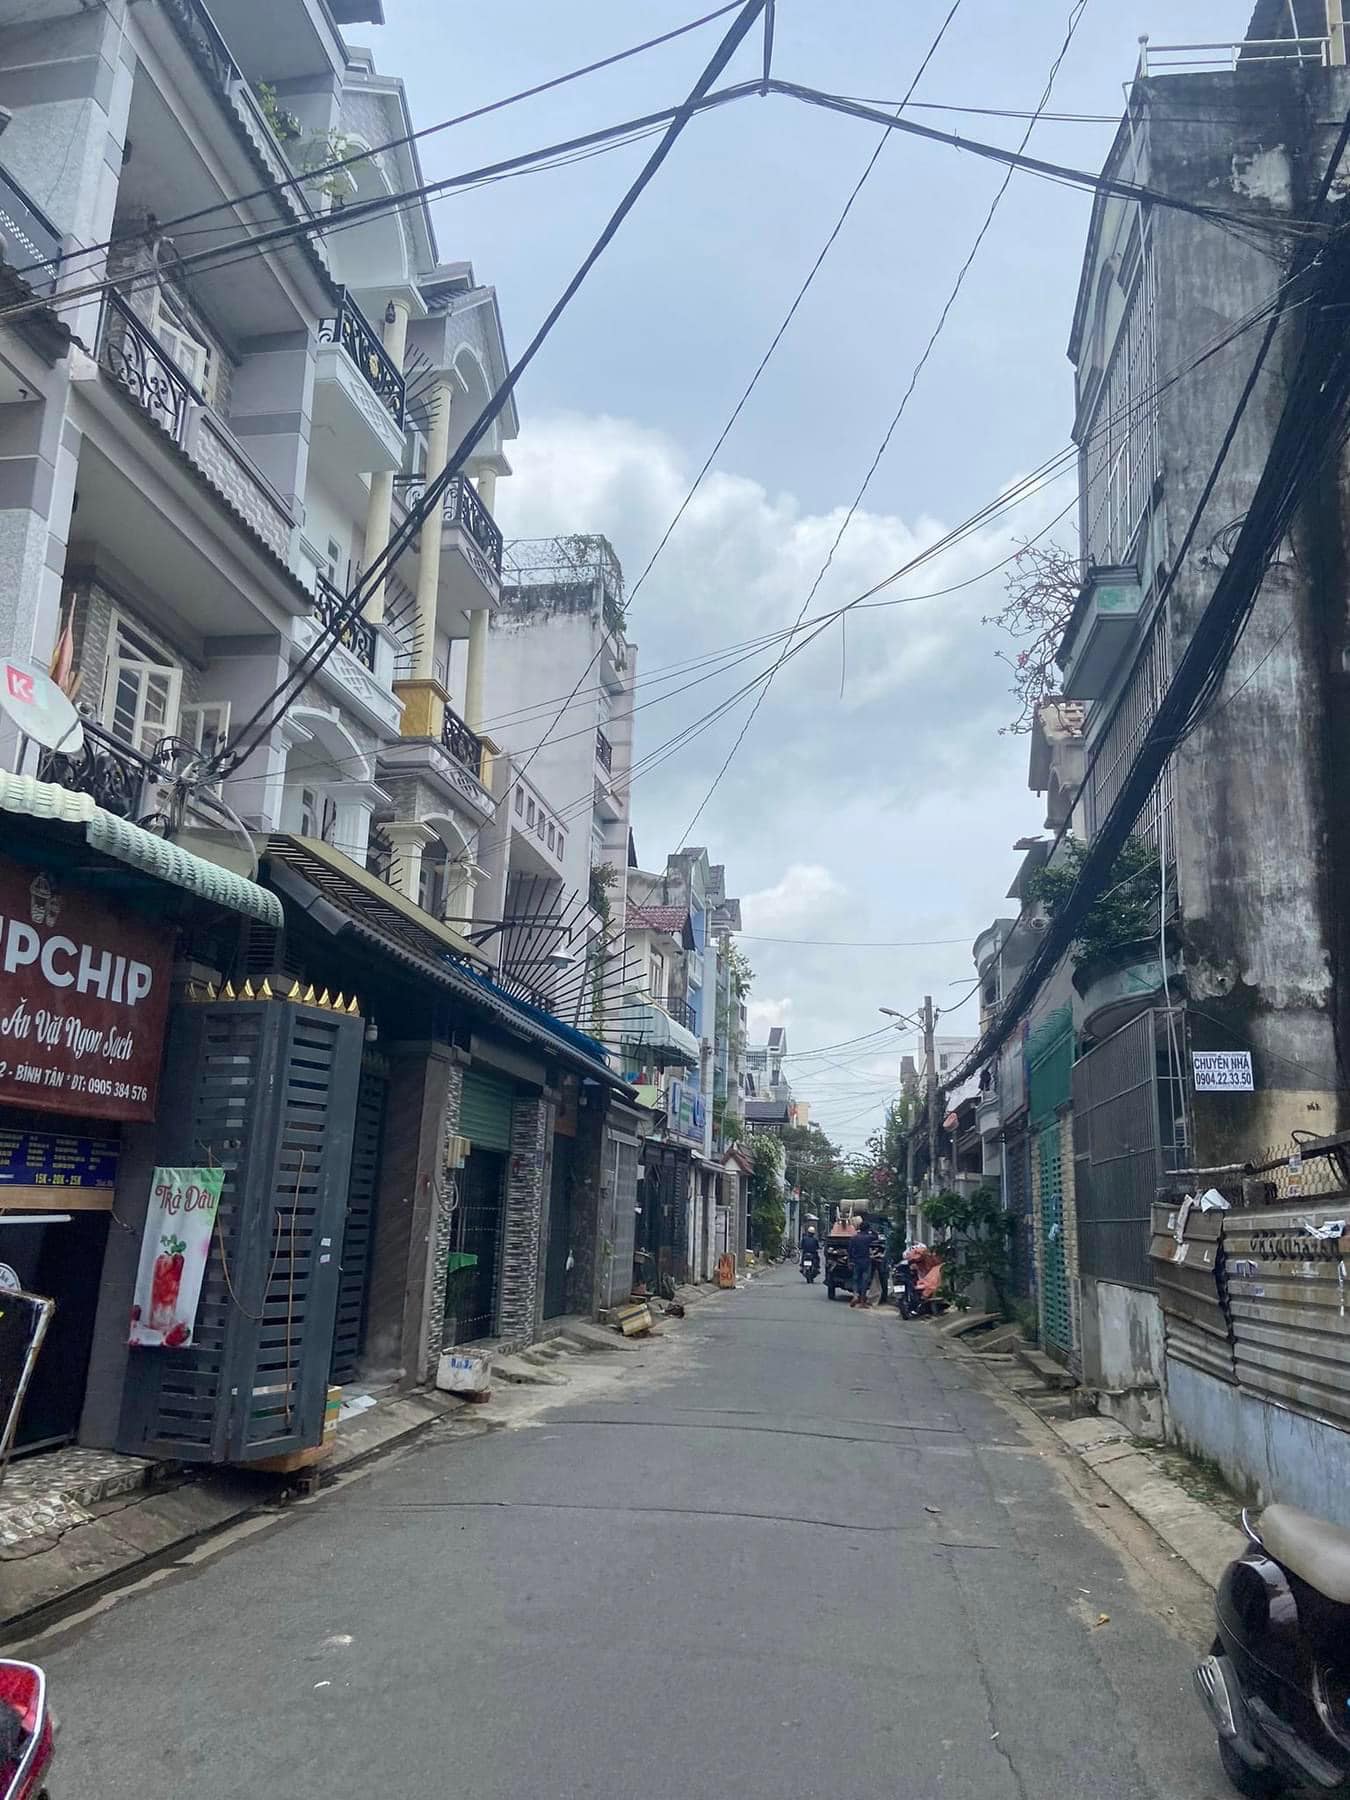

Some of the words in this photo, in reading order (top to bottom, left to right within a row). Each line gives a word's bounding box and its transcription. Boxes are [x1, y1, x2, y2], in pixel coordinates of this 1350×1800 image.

[0, 915, 153, 1006] PCHIP
[1, 996, 32, 1039] Ăn
[35, 1009, 64, 1051] Vặt
[65, 1016, 104, 1060] Ngon
[102, 1025, 134, 1065] Sạch
[14, 1061, 42, 1084] BÌNH
[44, 1066, 65, 1088] TÂN
[88, 1077, 112, 1096] 0905
[113, 1082, 130, 1099] 384
[131, 1085, 148, 1102] 576
[184, 1185, 215, 1212] Dâu
